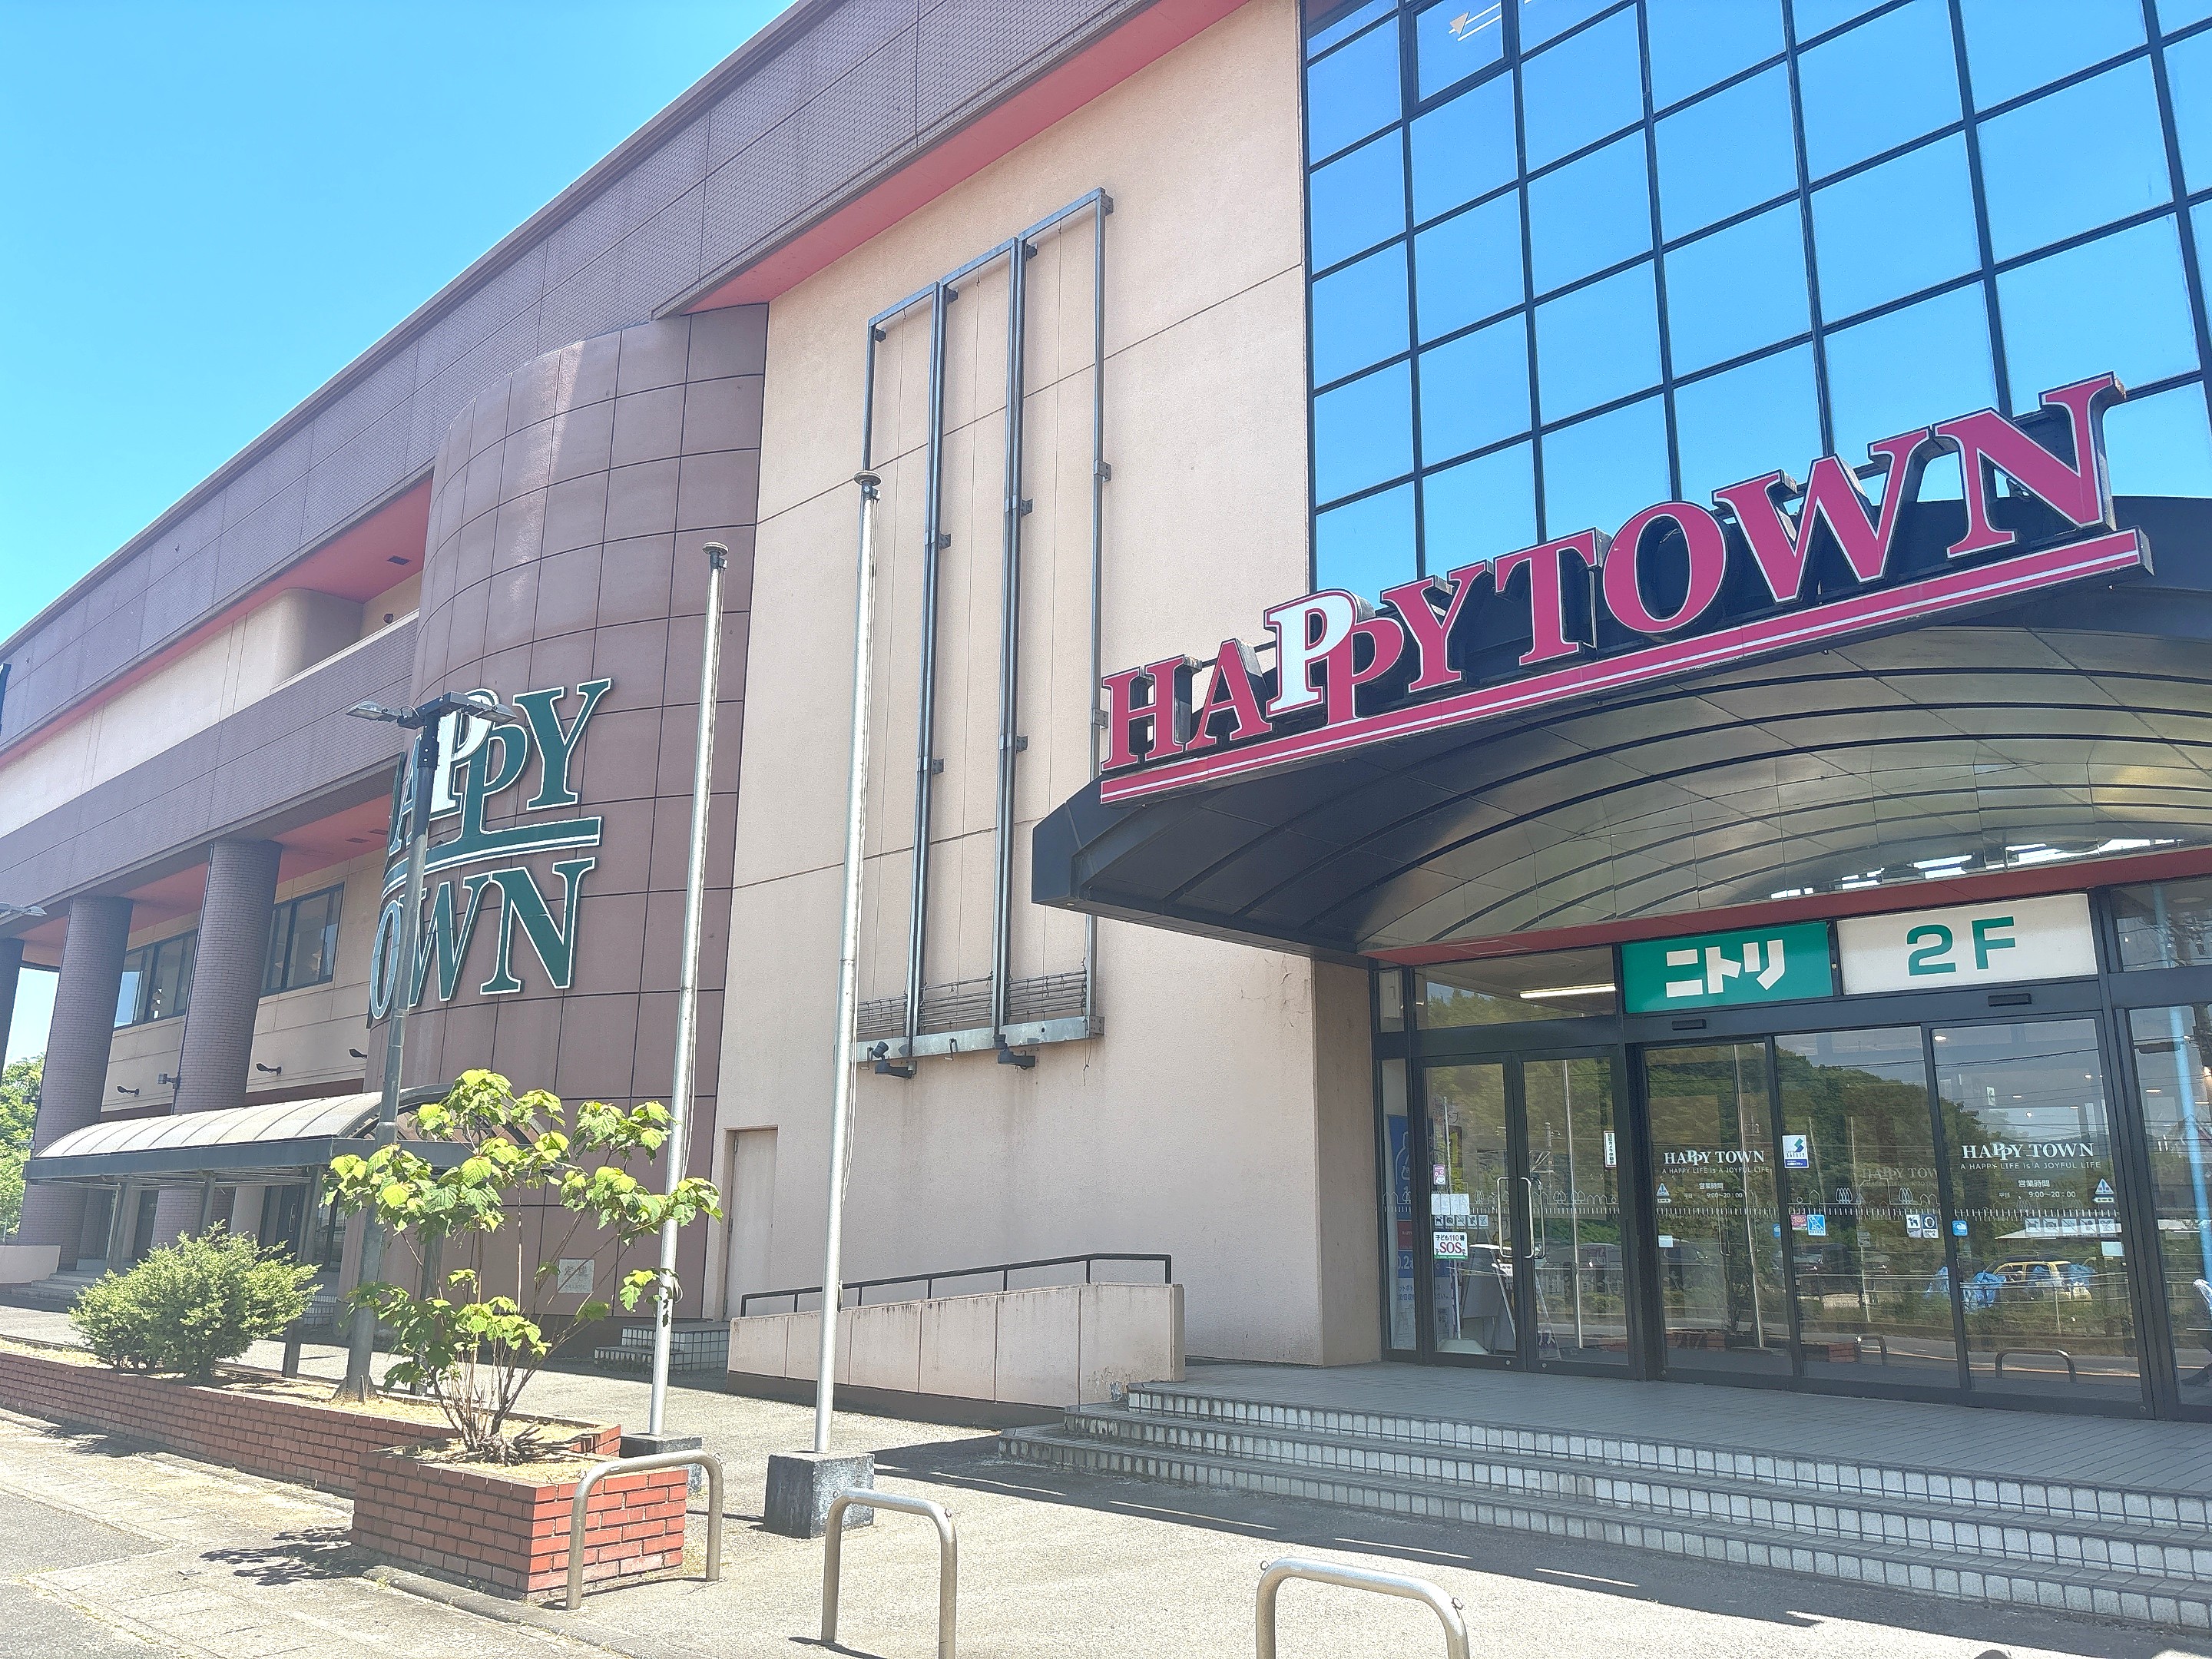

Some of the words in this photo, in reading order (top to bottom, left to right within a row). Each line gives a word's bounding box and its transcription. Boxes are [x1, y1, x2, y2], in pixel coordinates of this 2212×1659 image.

[386, 677, 613, 862] APPY
[369, 857, 596, 1020] OWN
[1906, 916, 2016, 977] 2F
[1665, 938, 1786, 998] ニトリ
[1664, 1149, 1712, 1166] HAPPY
[1715, 1150, 1765, 1164] TOWN
[1961, 1142, 2024, 1161] HAPPY
[2028, 1142, 2094, 1158] TOWN
[1908, 1167, 1938, 1178] TOW
[2018, 1180, 2050, 1188] 営業時間
[1439, 1241, 1462, 1253] SOS
